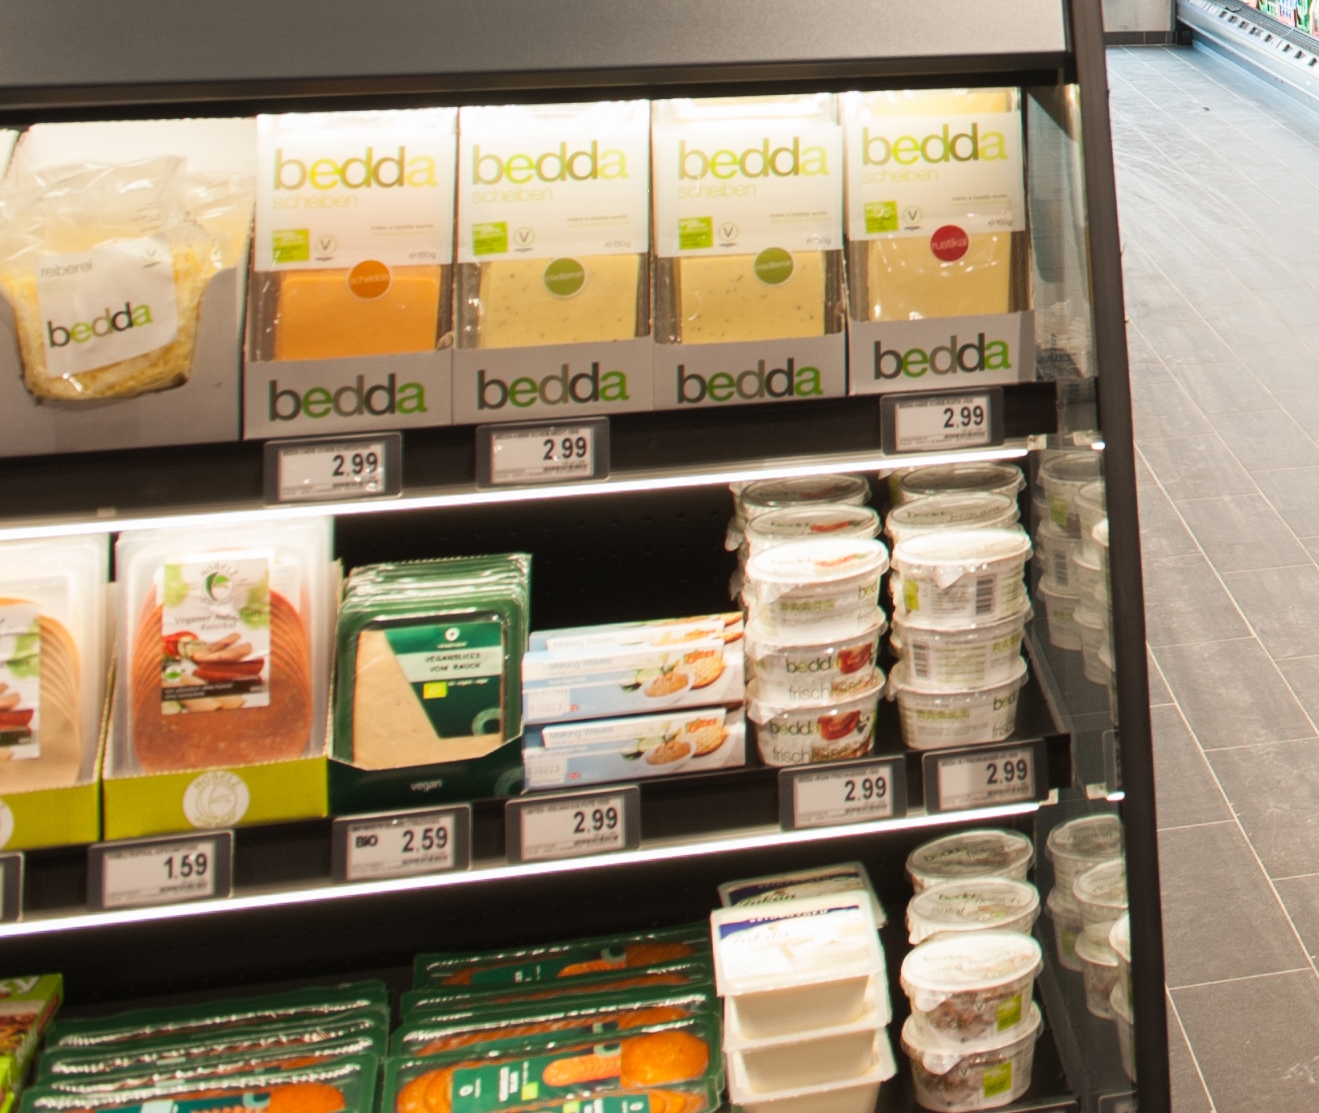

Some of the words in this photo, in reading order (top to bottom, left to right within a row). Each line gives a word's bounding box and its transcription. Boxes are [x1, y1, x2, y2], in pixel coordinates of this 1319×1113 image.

[862, 122, 1008, 166] bedda
[274, 146, 437, 191] bedda
[472, 140, 629, 185] bedda
[678, 136, 830, 180] bedda
[862, 168, 938, 184] scheiben
[273, 193, 358, 210] scheiben
[471, 187, 553, 204] scheiben
[677, 182, 757, 199] scheiben
[932, 235, 968, 251] rustikal
[47, 301, 153, 348] bedda
[873, 333, 1011, 380] bedda
[477, 361, 629, 411] bedda
[677, 357, 823, 405] bedda
[268, 373, 427, 422] bedda
[943, 405, 985, 430] 2.99
[542, 436, 588, 461] 2.99
[332, 452, 378, 477] 2.99
[425, 652, 481, 663] VEGANSLICES
[429, 665, 449, 673] VOM
[452, 662, 481, 671] RAUCH
[986, 759, 1028, 784] 2.99
[410, 779, 443, 791] vegan
[844, 777, 888, 802] 2.99
[574, 807, 619, 833] 2.99
[355, 833, 378, 849] BIO
[401, 826, 449, 853] 2.59
[162, 851, 208, 880] 1.59
